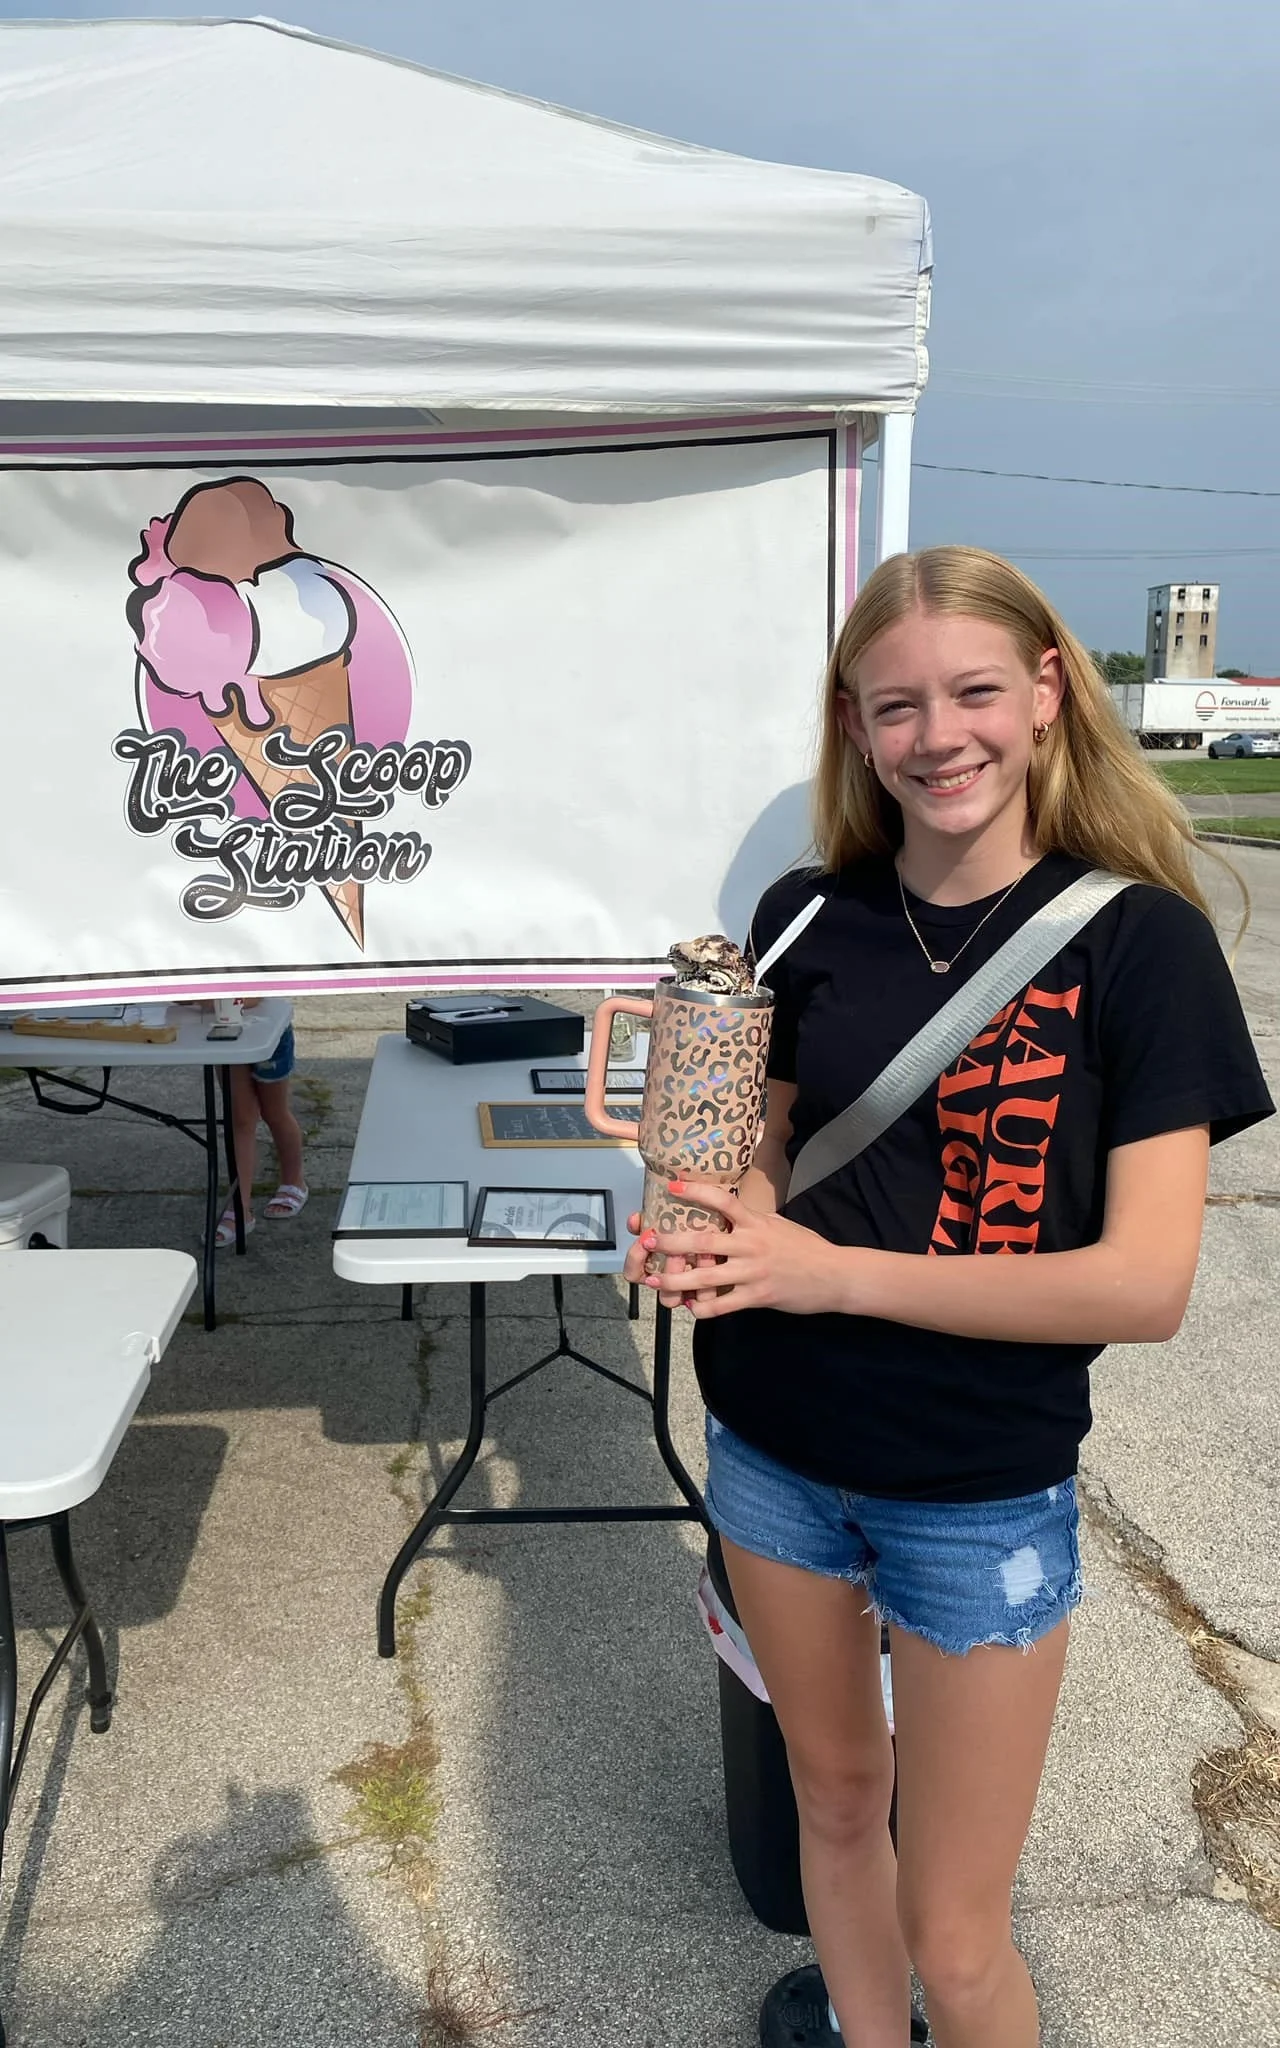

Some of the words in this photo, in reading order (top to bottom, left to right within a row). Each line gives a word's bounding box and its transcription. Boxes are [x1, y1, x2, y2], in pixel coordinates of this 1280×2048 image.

[1221, 696, 1257, 706] Forward
[1257, 696, 1272, 706] Air
[112, 733, 237, 836] The
[262, 725, 471, 829] Scoop
[172, 822, 431, 923] Station
[928, 1001, 1018, 1255] DAIGL
[975, 983, 1081, 1255] LAURE
